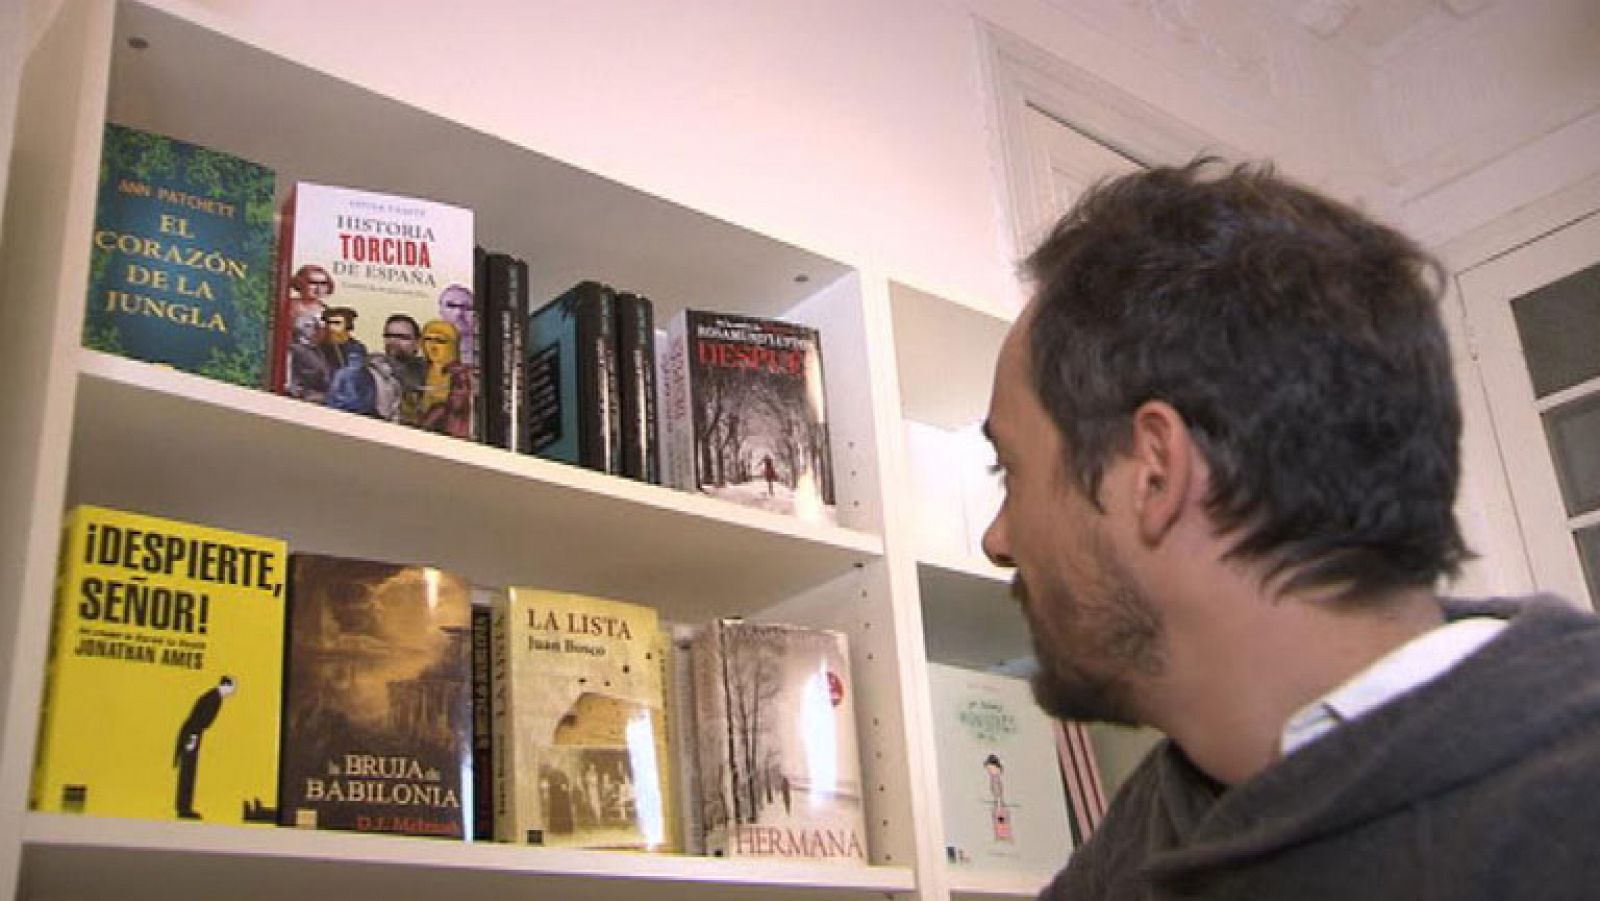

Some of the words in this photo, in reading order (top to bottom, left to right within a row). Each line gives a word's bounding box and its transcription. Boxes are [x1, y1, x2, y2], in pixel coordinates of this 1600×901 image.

[118, 179, 151, 197] ANN
[157, 188, 236, 217] PATCHETT
[159, 214, 194, 237] EL
[336, 213, 435, 242] HISTORIA
[95, 231, 249, 279] CORAZÓN
[339, 233, 432, 268] TORCIDA
[127, 264, 167, 289] DE
[176, 273, 216, 300] LA
[333, 260, 359, 276] DE
[366, 264, 436, 287] ESPAÑA
[105, 291, 229, 333] JUNGLA
[86, 525, 282, 597] ¡DESPIERTE,
[80, 578, 209, 634] SEÑOR!
[527, 610, 561, 632] LA
[568, 613, 633, 641] LISTA
[74, 640, 156, 664] JONATHAN
[159, 648, 204, 670] AMES
[528, 636, 561, 654] Juan
[564, 640, 607, 657] Bosco
[345, 753, 424, 781] BRUJA
[305, 778, 461, 809] BABILONIA
[736, 824, 867, 858] HERMANA
